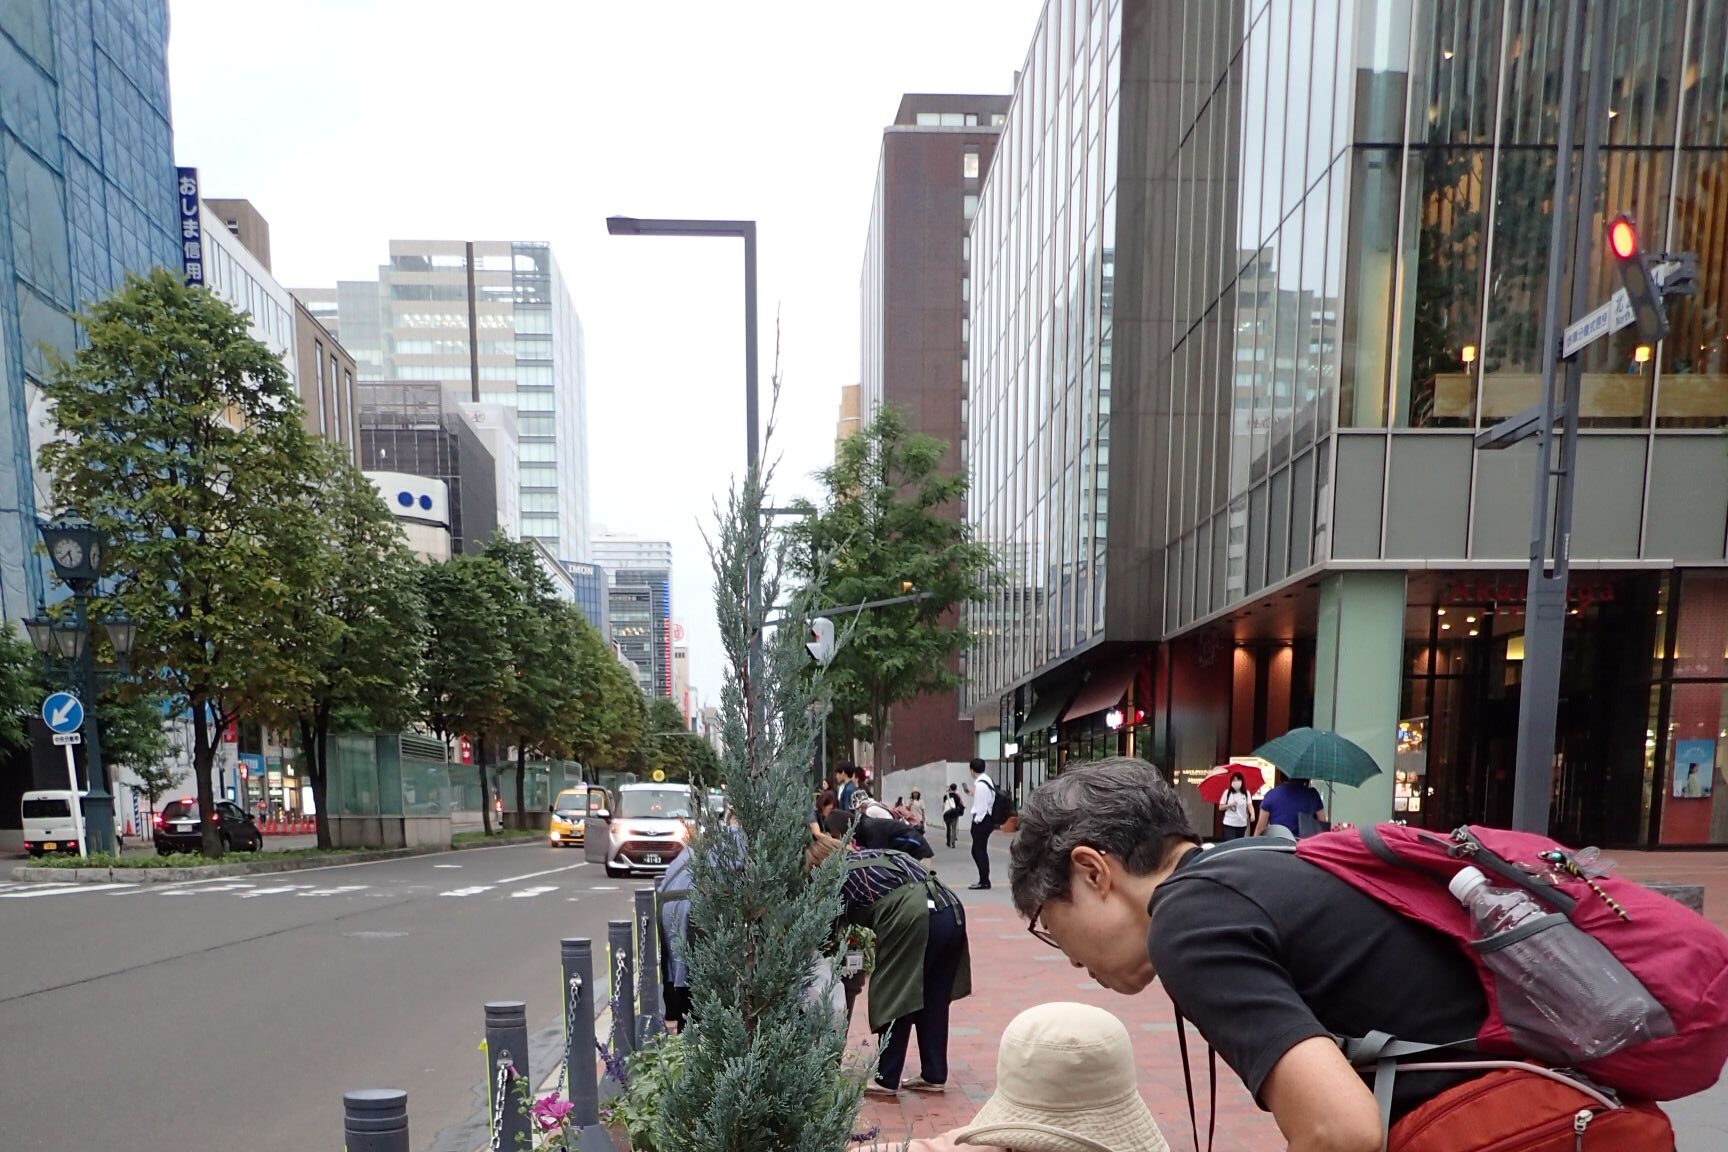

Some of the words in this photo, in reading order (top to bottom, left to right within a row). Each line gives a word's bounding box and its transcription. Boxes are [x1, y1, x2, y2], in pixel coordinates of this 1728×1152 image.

[179, 176, 203, 288] おしま信用
